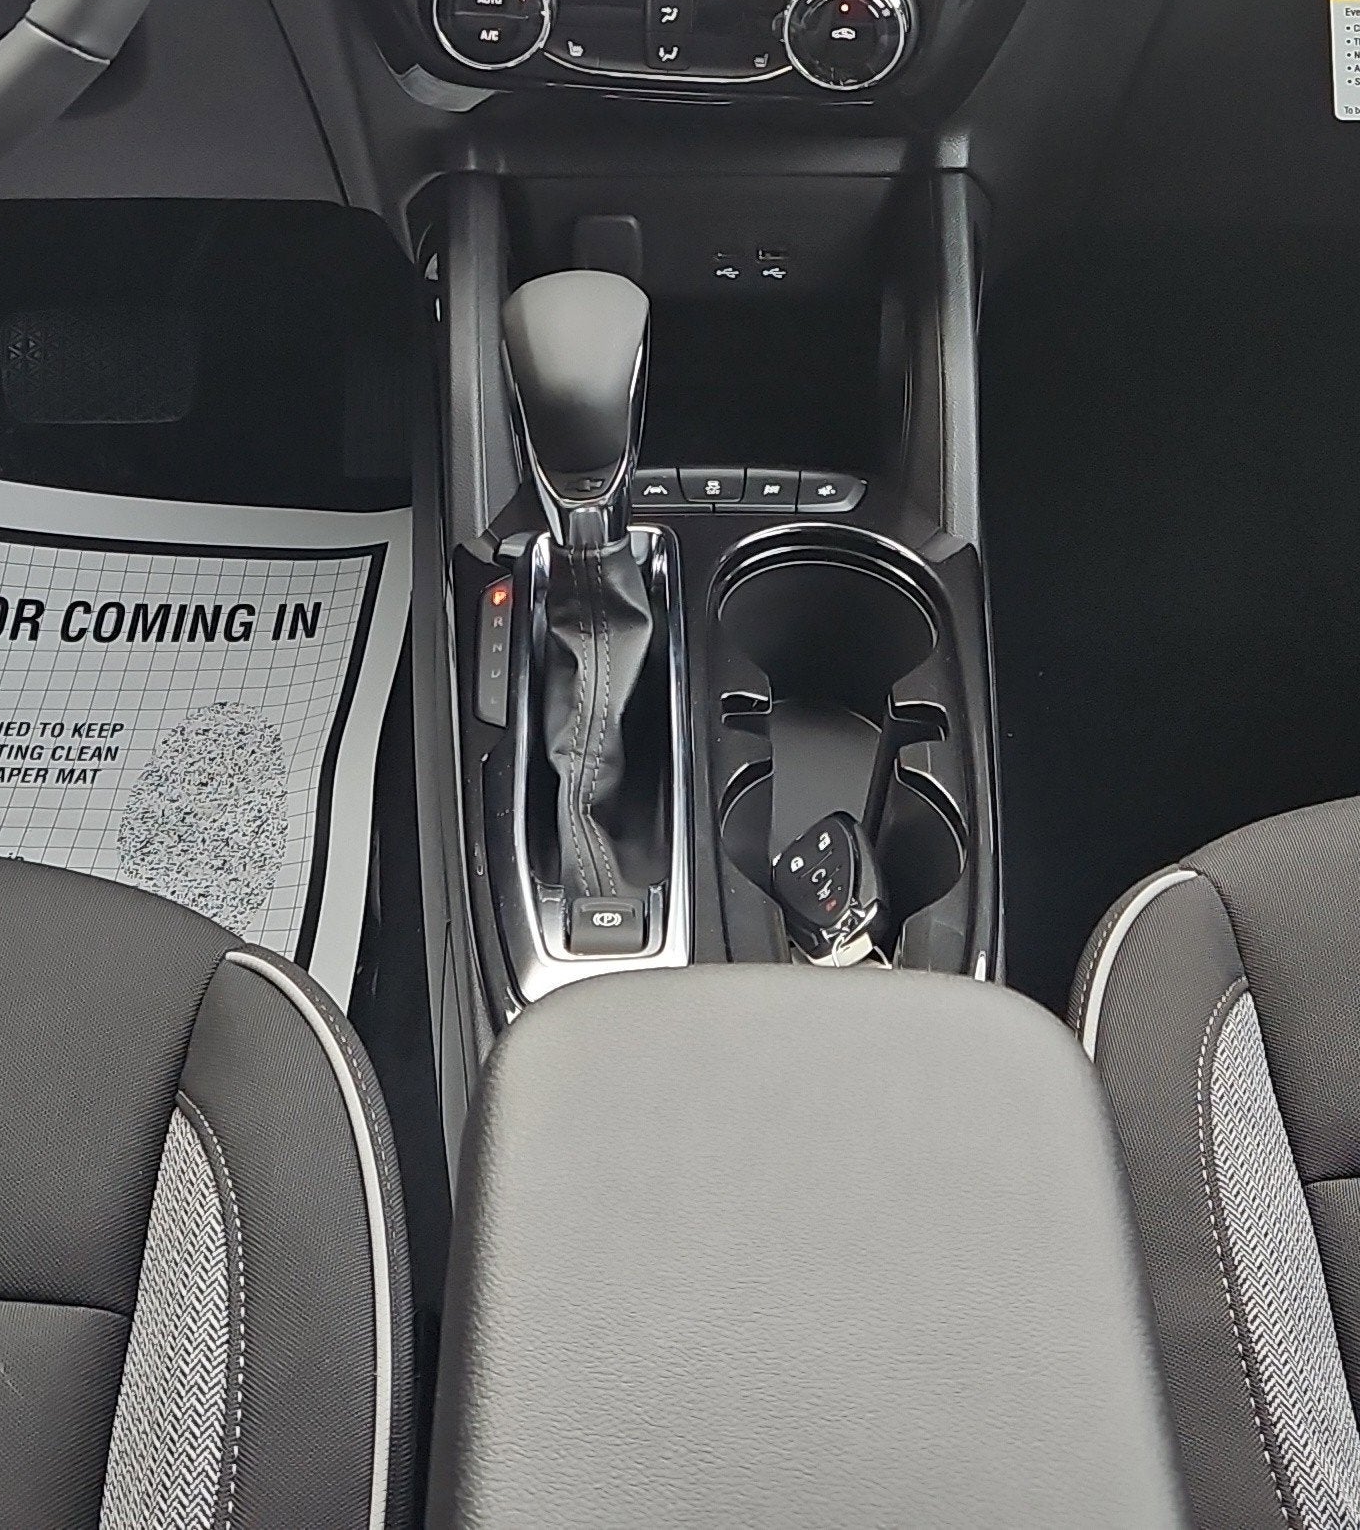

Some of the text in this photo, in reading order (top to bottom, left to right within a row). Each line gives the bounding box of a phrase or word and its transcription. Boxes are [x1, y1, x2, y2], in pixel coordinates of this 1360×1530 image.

[480, 29, 499, 41] A/C
[1344, 106, 1353, 115] To
[493, 591, 507, 605] P
[59, 600, 257, 643] COMING
[271, 601, 323, 642] IN
[493, 616, 503, 628] R
[492, 643, 503, 653] N
[39, 722, 65, 738] TO
[71, 722, 125, 739] KEEP
[50, 745, 120, 762] CLEAN
[54, 768, 102, 785] MAT
